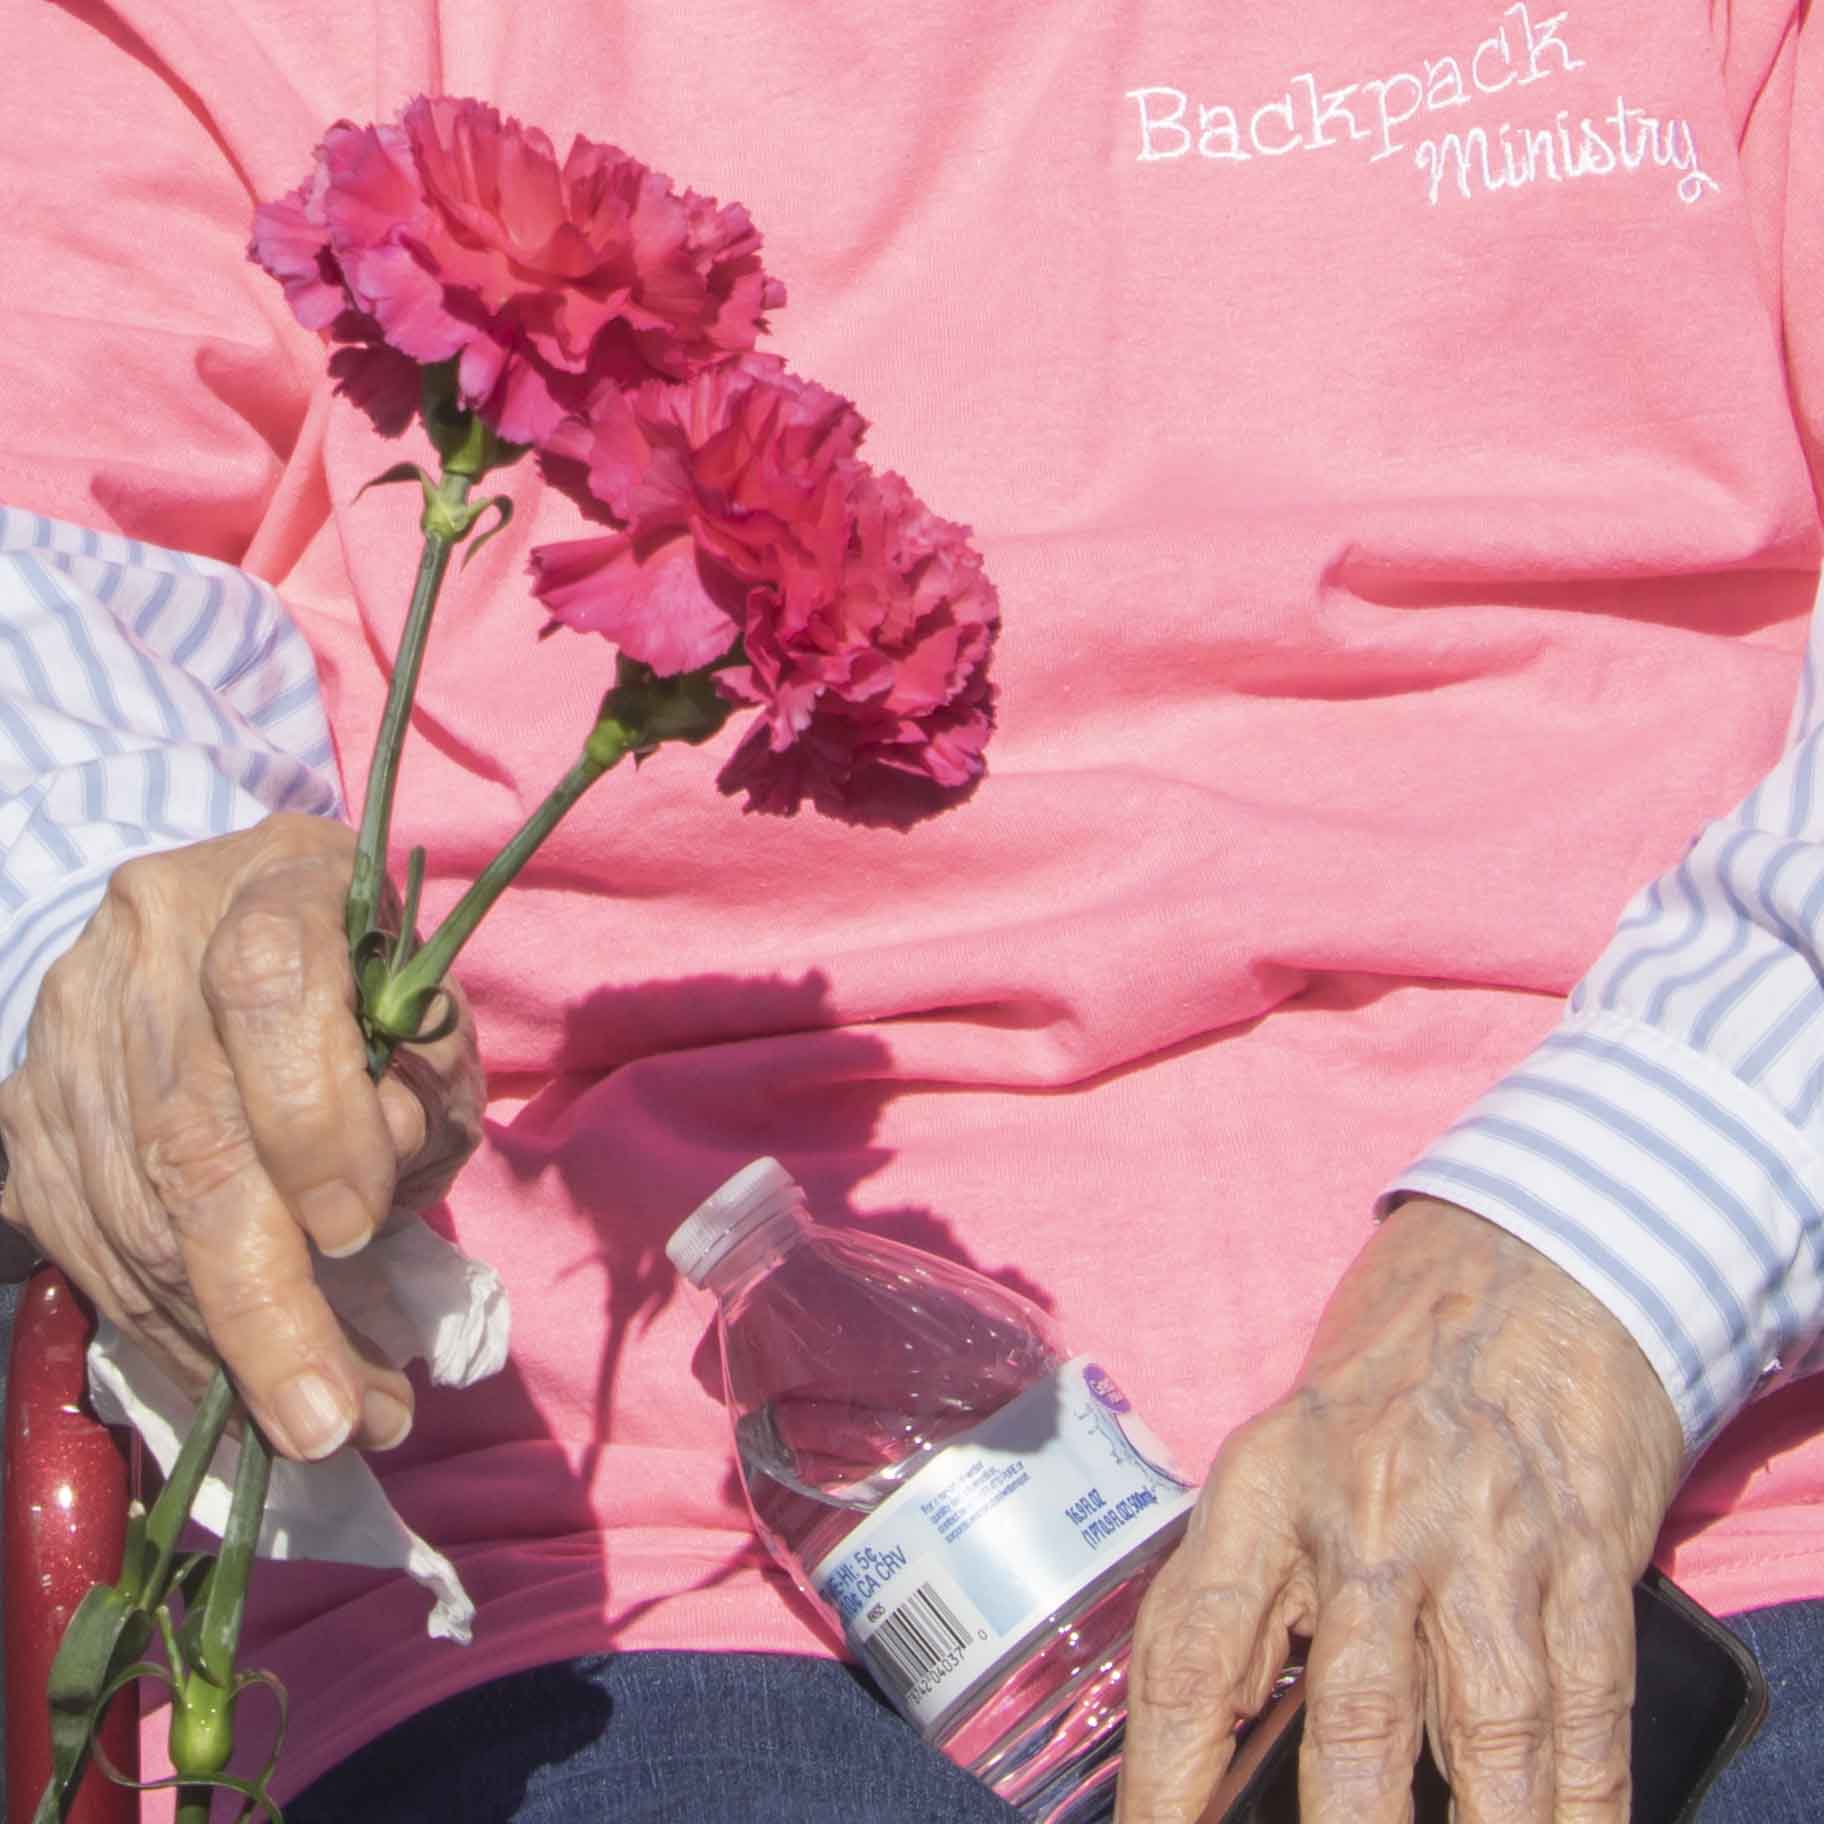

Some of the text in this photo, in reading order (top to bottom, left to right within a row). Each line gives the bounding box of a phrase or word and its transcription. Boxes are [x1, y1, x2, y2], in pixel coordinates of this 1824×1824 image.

[1126, 2, 1585, 162] Backpack
[1415, 95, 1720, 205] Ministry
[856, 1573, 881, 1599] CA
[875, 1545, 907, 1581] CRV
[928, 1646, 966, 1684] 04037
[977, 1627, 989, 1641] 0
